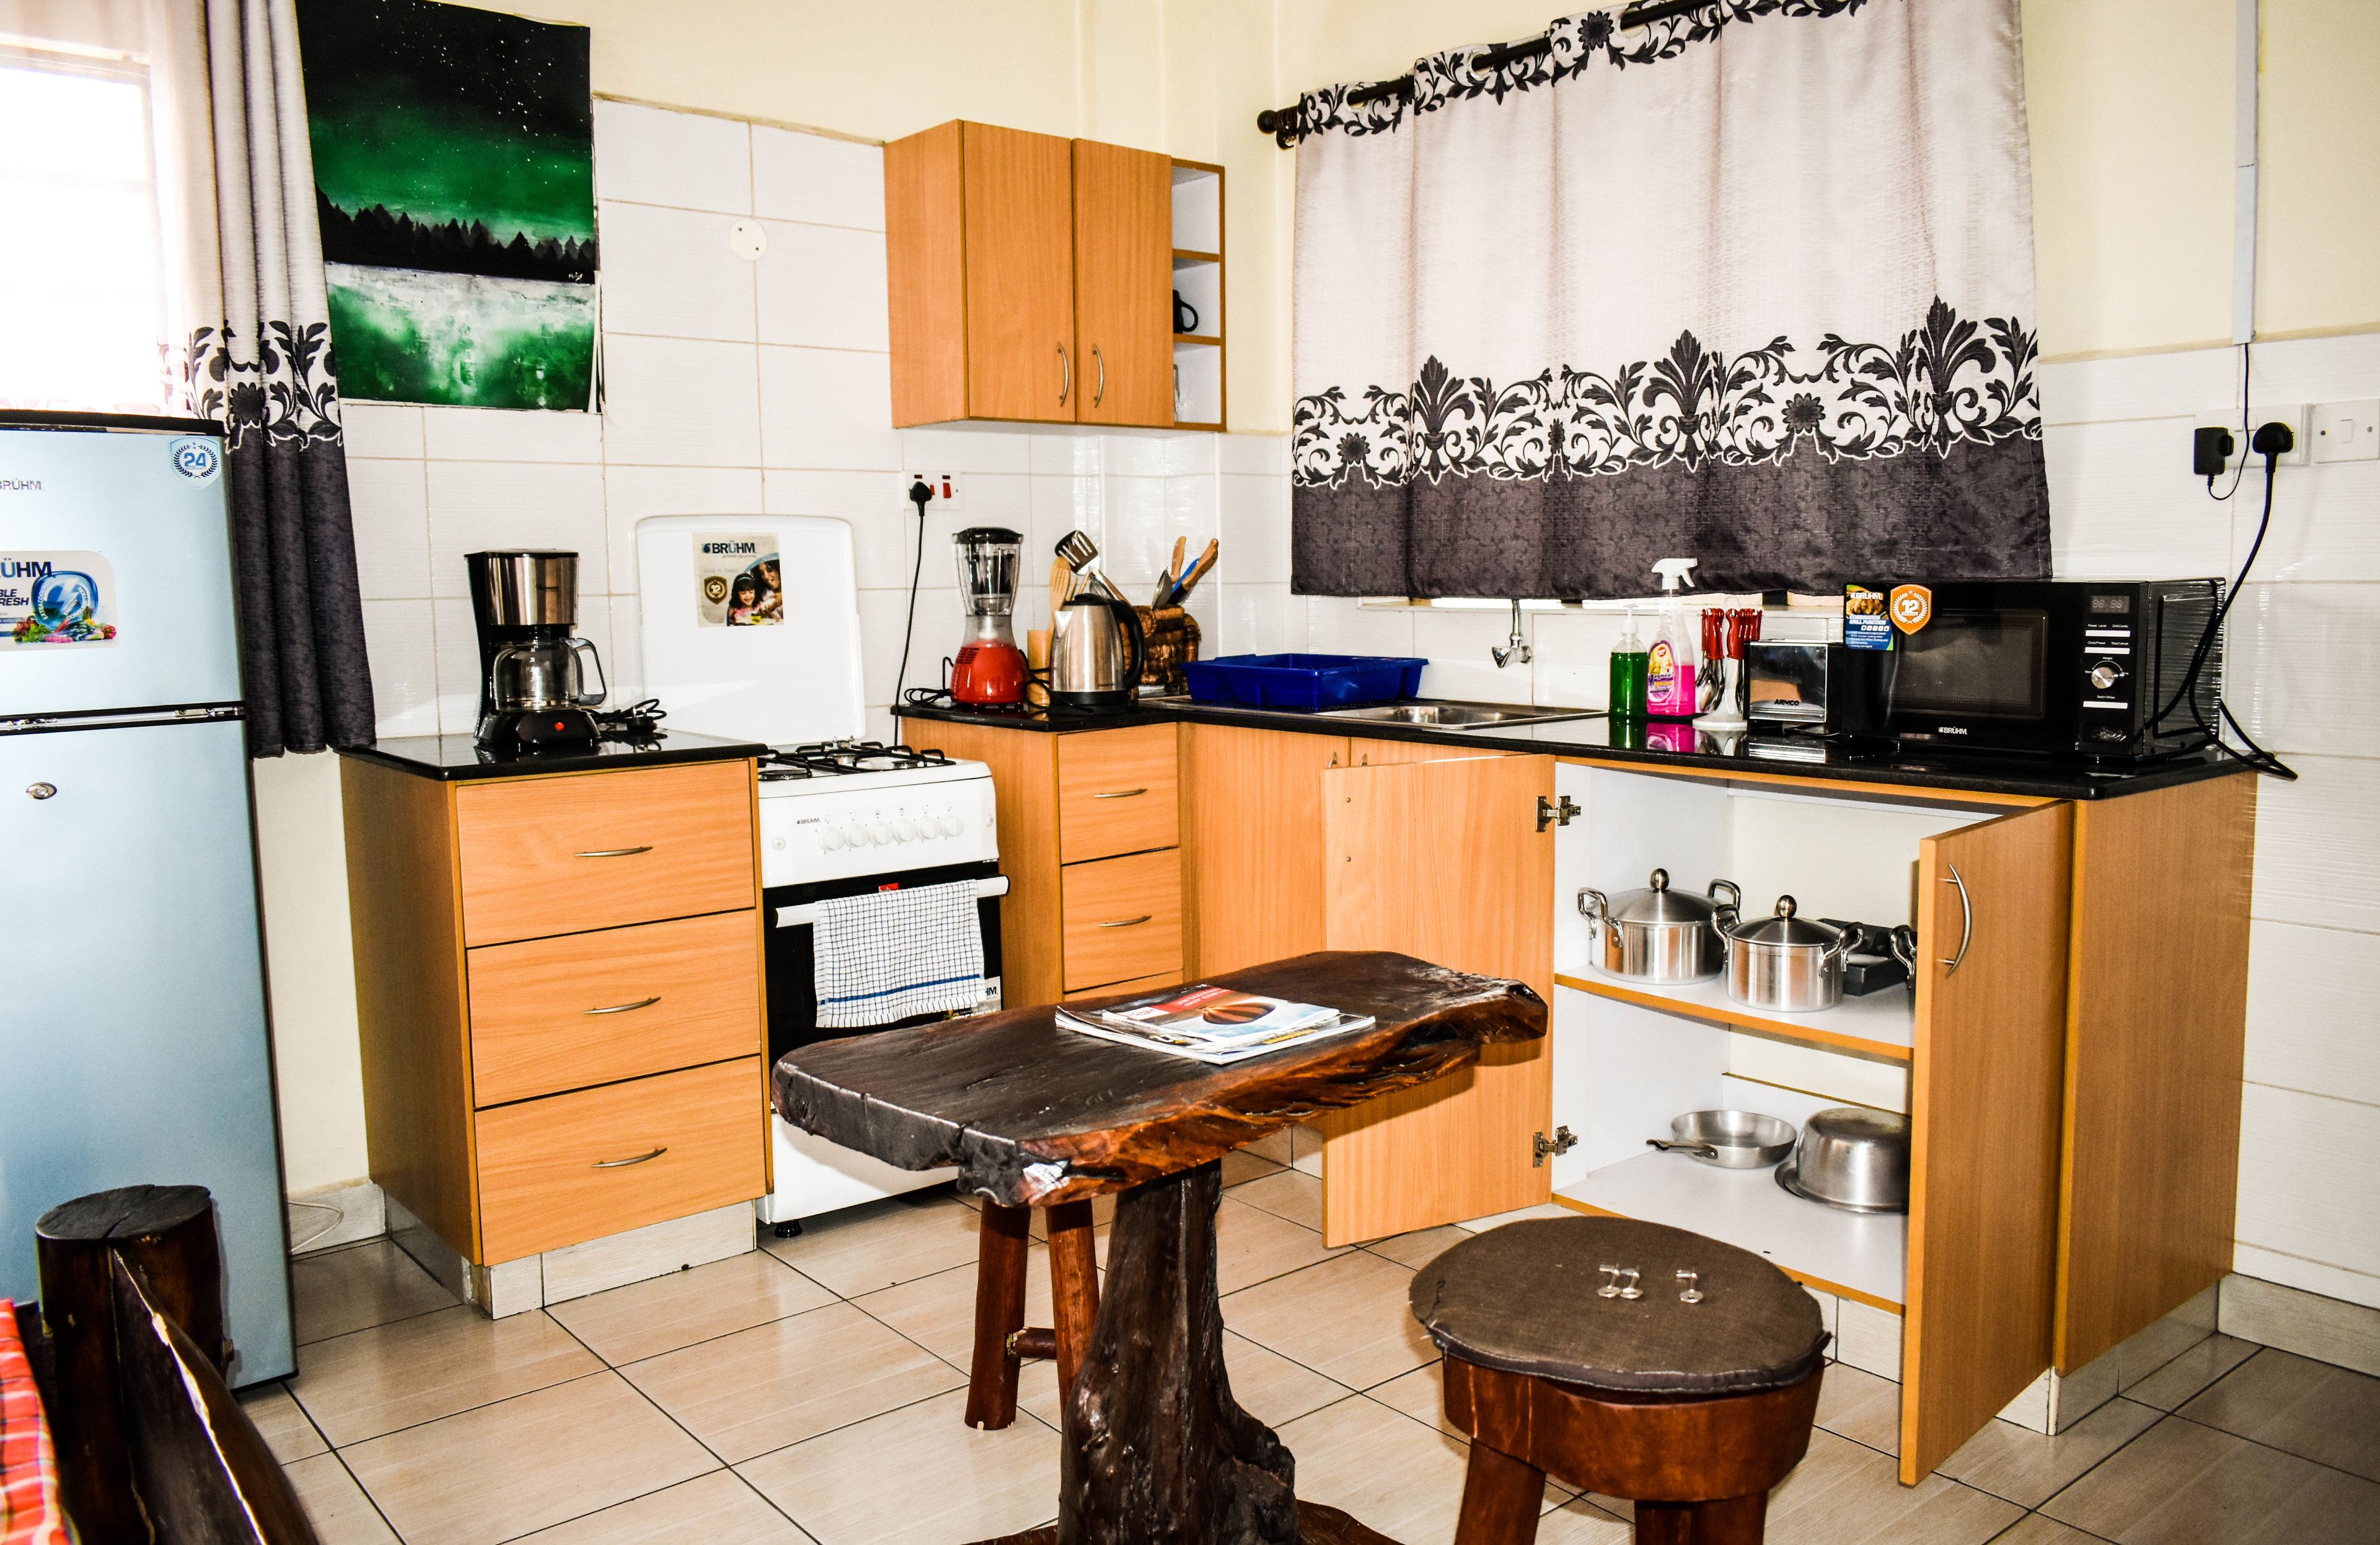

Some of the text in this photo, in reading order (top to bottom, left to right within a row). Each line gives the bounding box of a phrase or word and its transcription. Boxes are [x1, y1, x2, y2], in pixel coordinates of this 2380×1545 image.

[183, 452, 206, 467] 24
[712, 540, 755, 554] BRÜHM
[0, 557, 52, 578] ÜHM
[1902, 599, 1918, 613] 12
